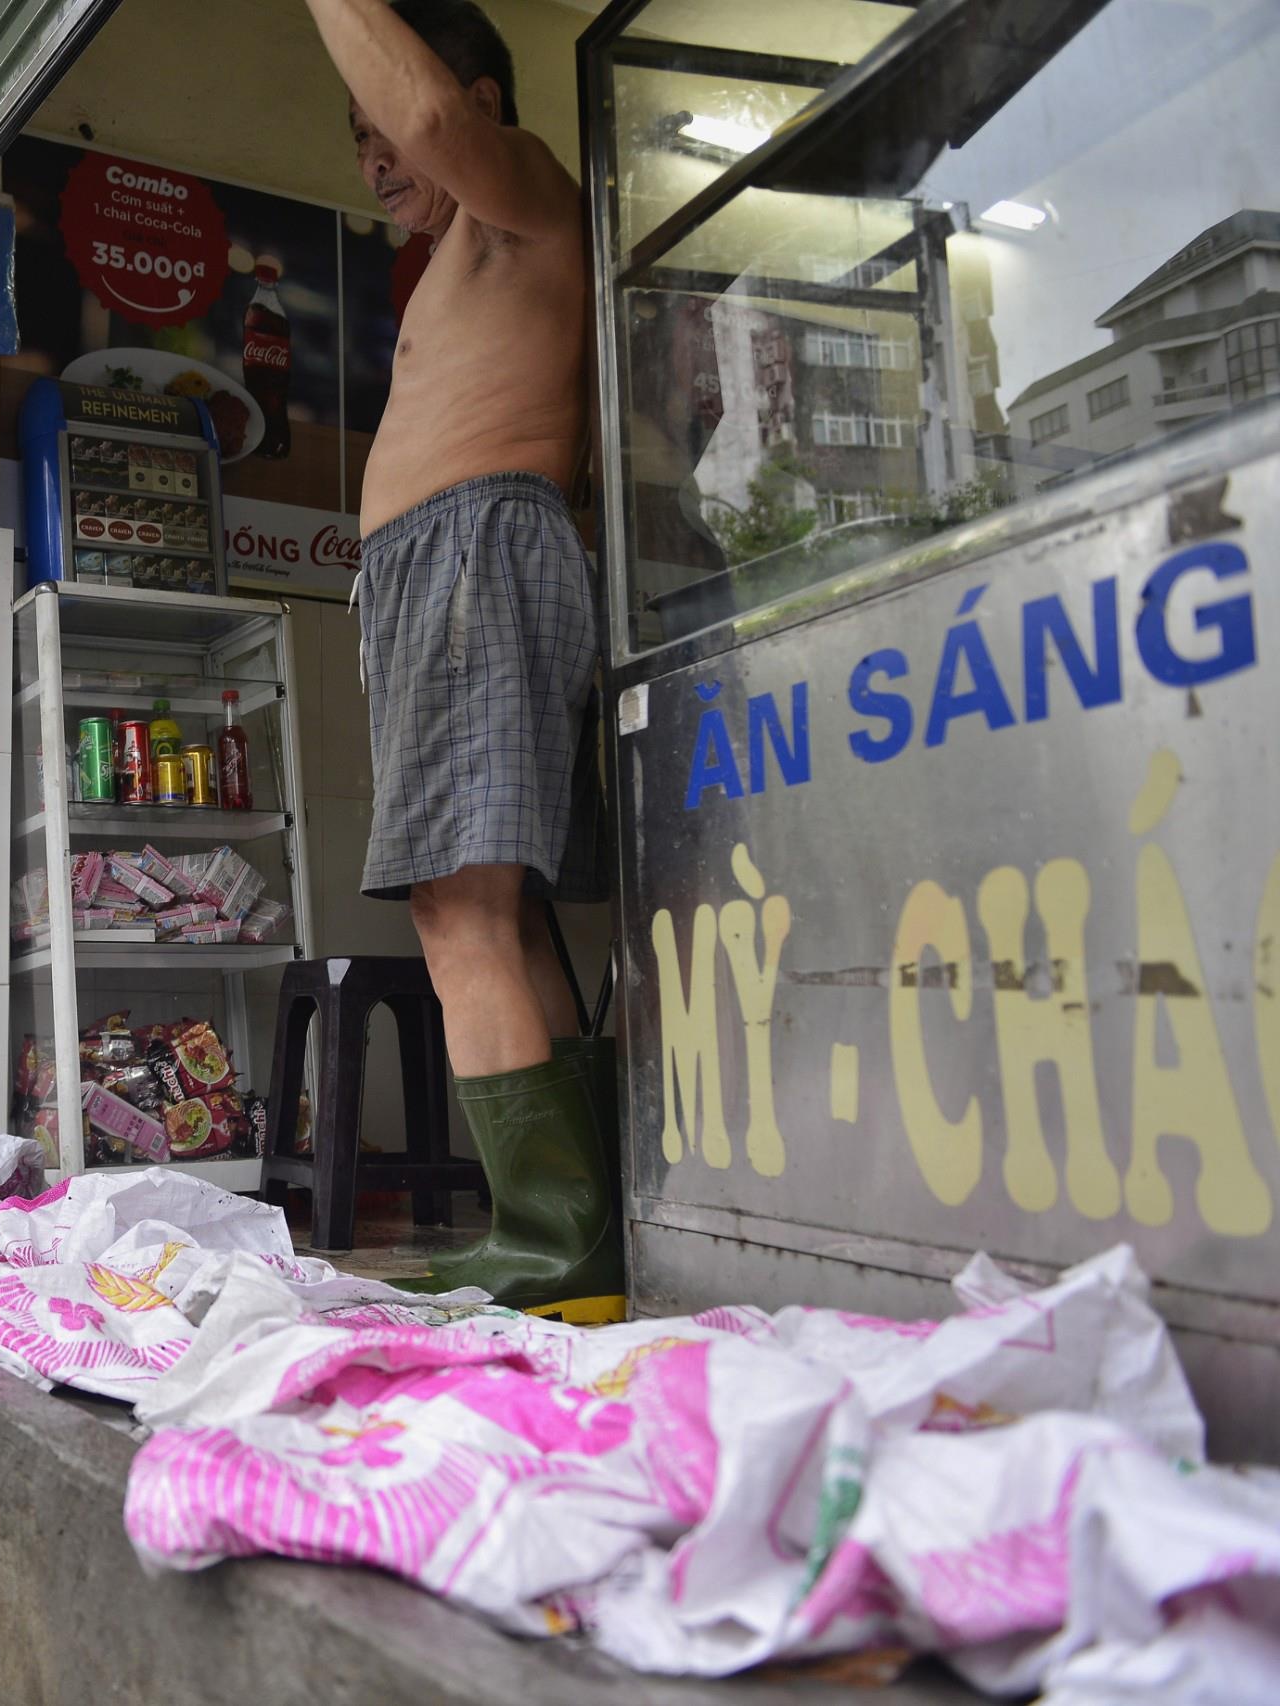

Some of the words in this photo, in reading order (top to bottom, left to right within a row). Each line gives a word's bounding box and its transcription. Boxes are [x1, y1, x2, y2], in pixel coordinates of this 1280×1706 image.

[106, 165, 188, 200] Combo
[94, 202, 100, 215] 1
[103, 204, 130, 222] chai
[135, 212, 202, 238] Coca-Cola
[111, 190, 142, 208] Cơm
[146, 198, 173, 215] suất
[92, 240, 205, 284] 35.000đ
[81, 400, 181, 425] REFINEMENT
[684, 679, 811, 810] ĂN
[847, 541, 1257, 764] SÁNG
[651, 842, 791, 1178] MỲ
